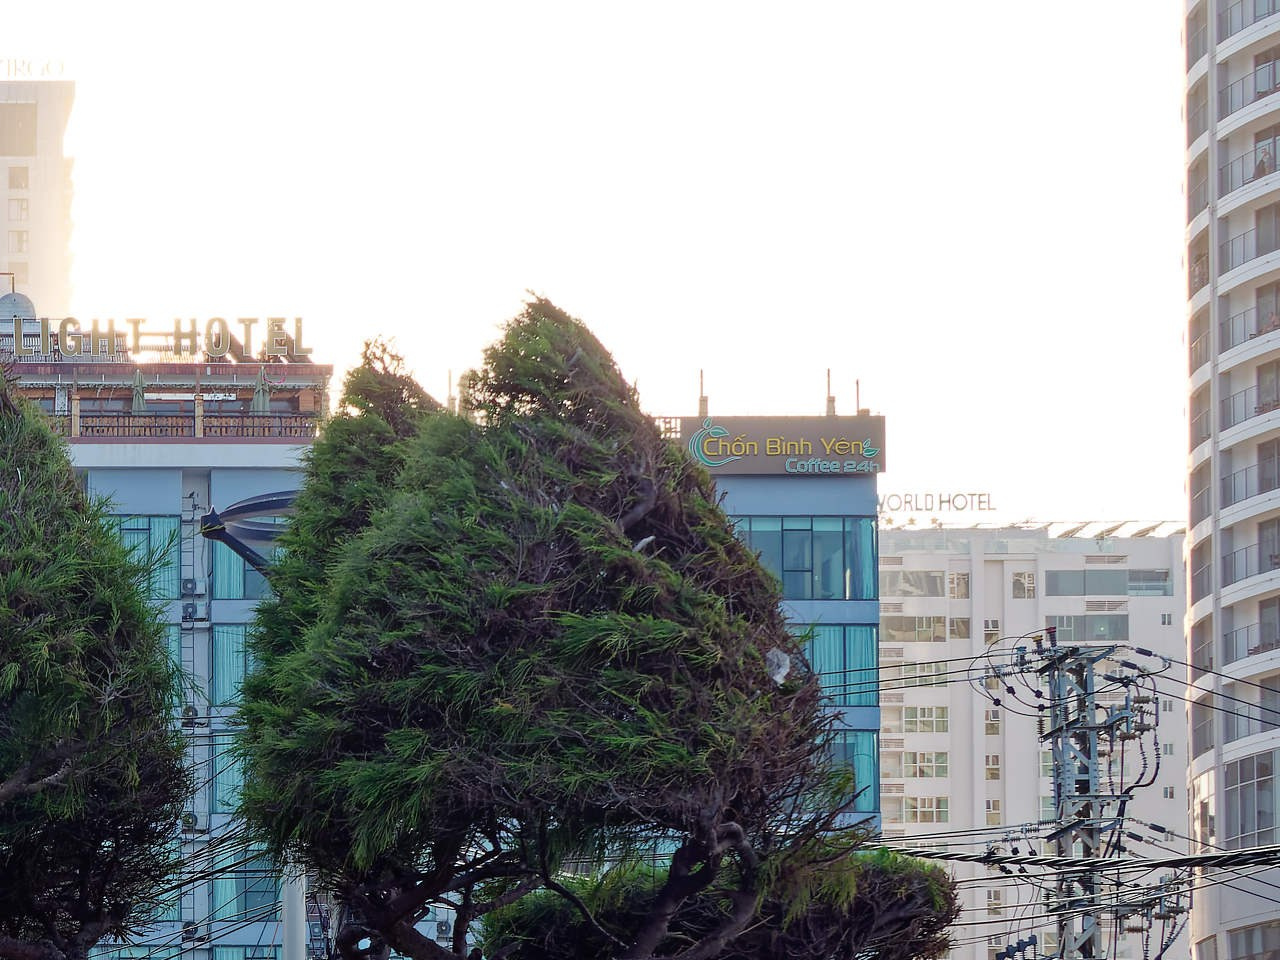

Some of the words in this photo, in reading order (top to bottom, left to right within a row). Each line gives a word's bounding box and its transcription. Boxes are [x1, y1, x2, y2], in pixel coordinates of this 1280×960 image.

[12, 316, 147, 357] LIGHT
[173, 316, 314, 357] HOTEL
[703, 433, 758, 456] Chốn
[766, 435, 812, 456] Bình
[820, 436, 863, 456] Yên
[785, 457, 840, 473] Coffee
[843, 460, 881, 473] 24h
[939, 493, 997, 511] HOTEL
